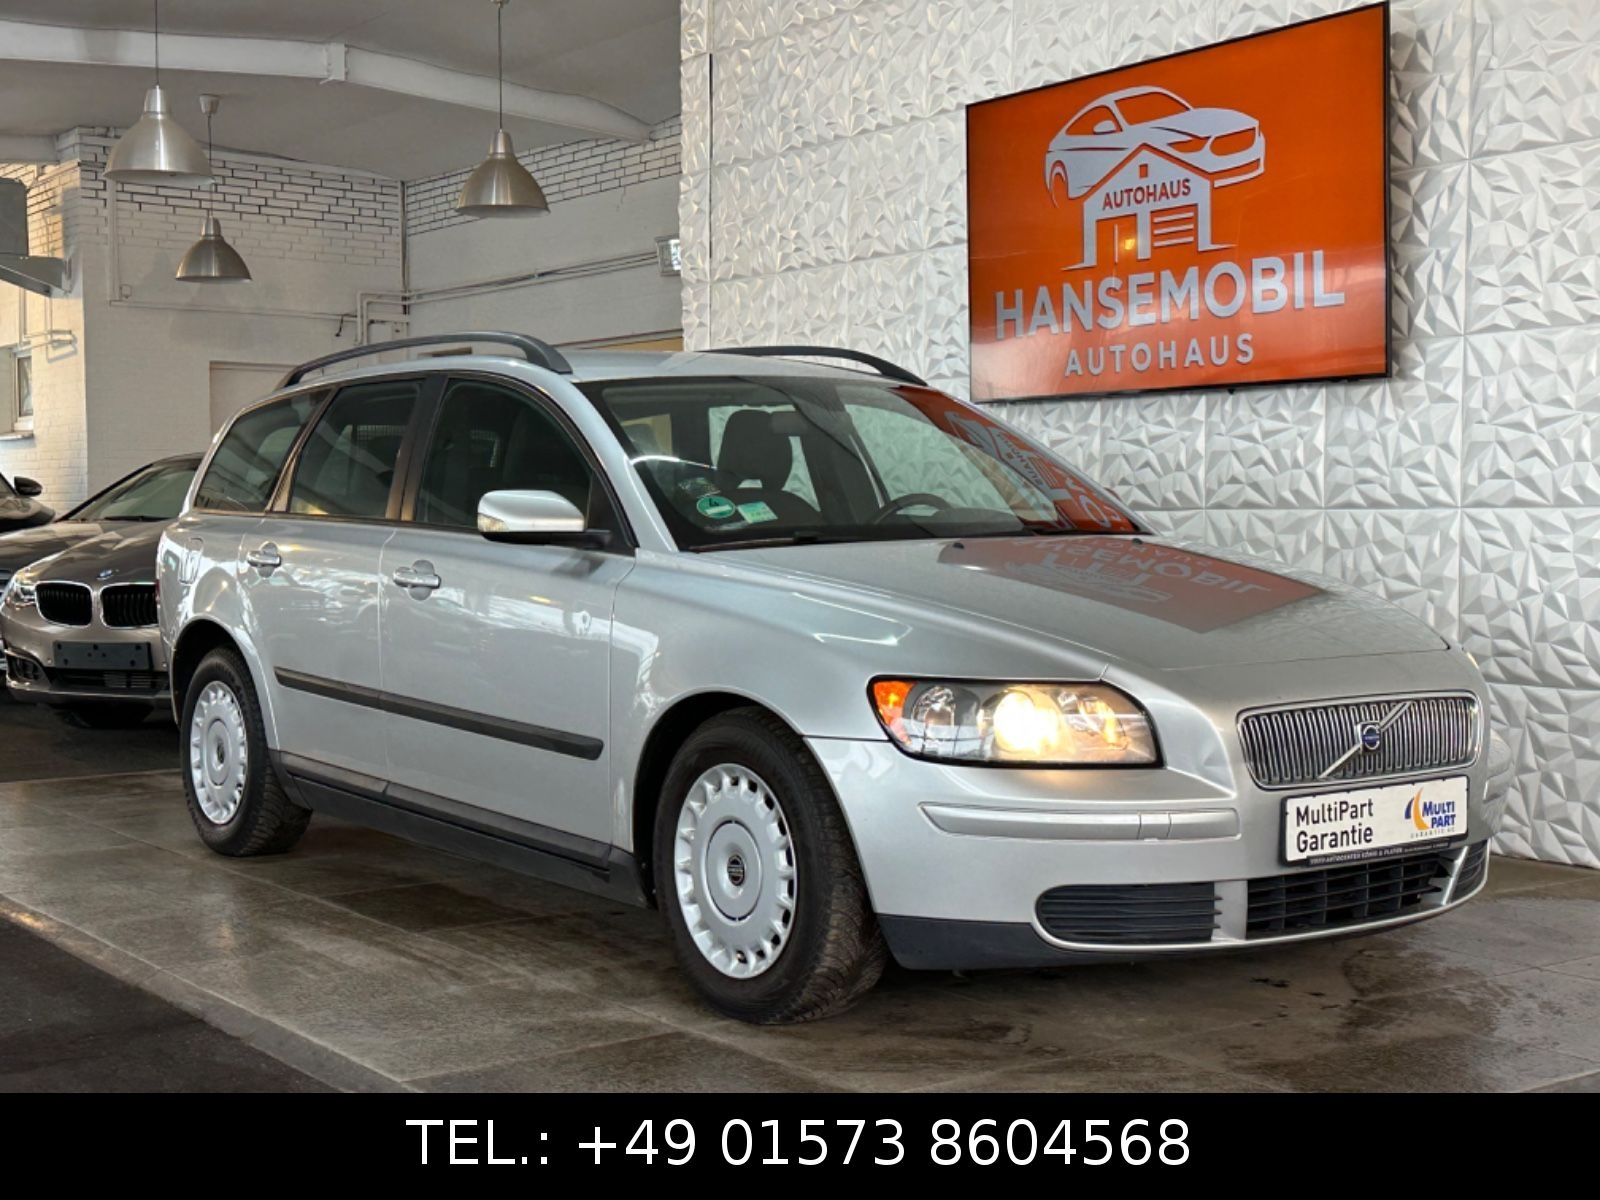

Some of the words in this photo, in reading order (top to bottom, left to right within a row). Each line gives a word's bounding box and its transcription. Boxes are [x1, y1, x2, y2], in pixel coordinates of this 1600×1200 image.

[1102, 178, 1192, 211] AUTOHAUS
[995, 250, 1346, 340] HANSEMOBIL
[1064, 333, 1254, 377] AUTOHAUS
[1296, 798, 1373, 827] MultiPart
[1431, 814, 1456, 829] PART
[1296, 822, 1373, 853] Garantie
